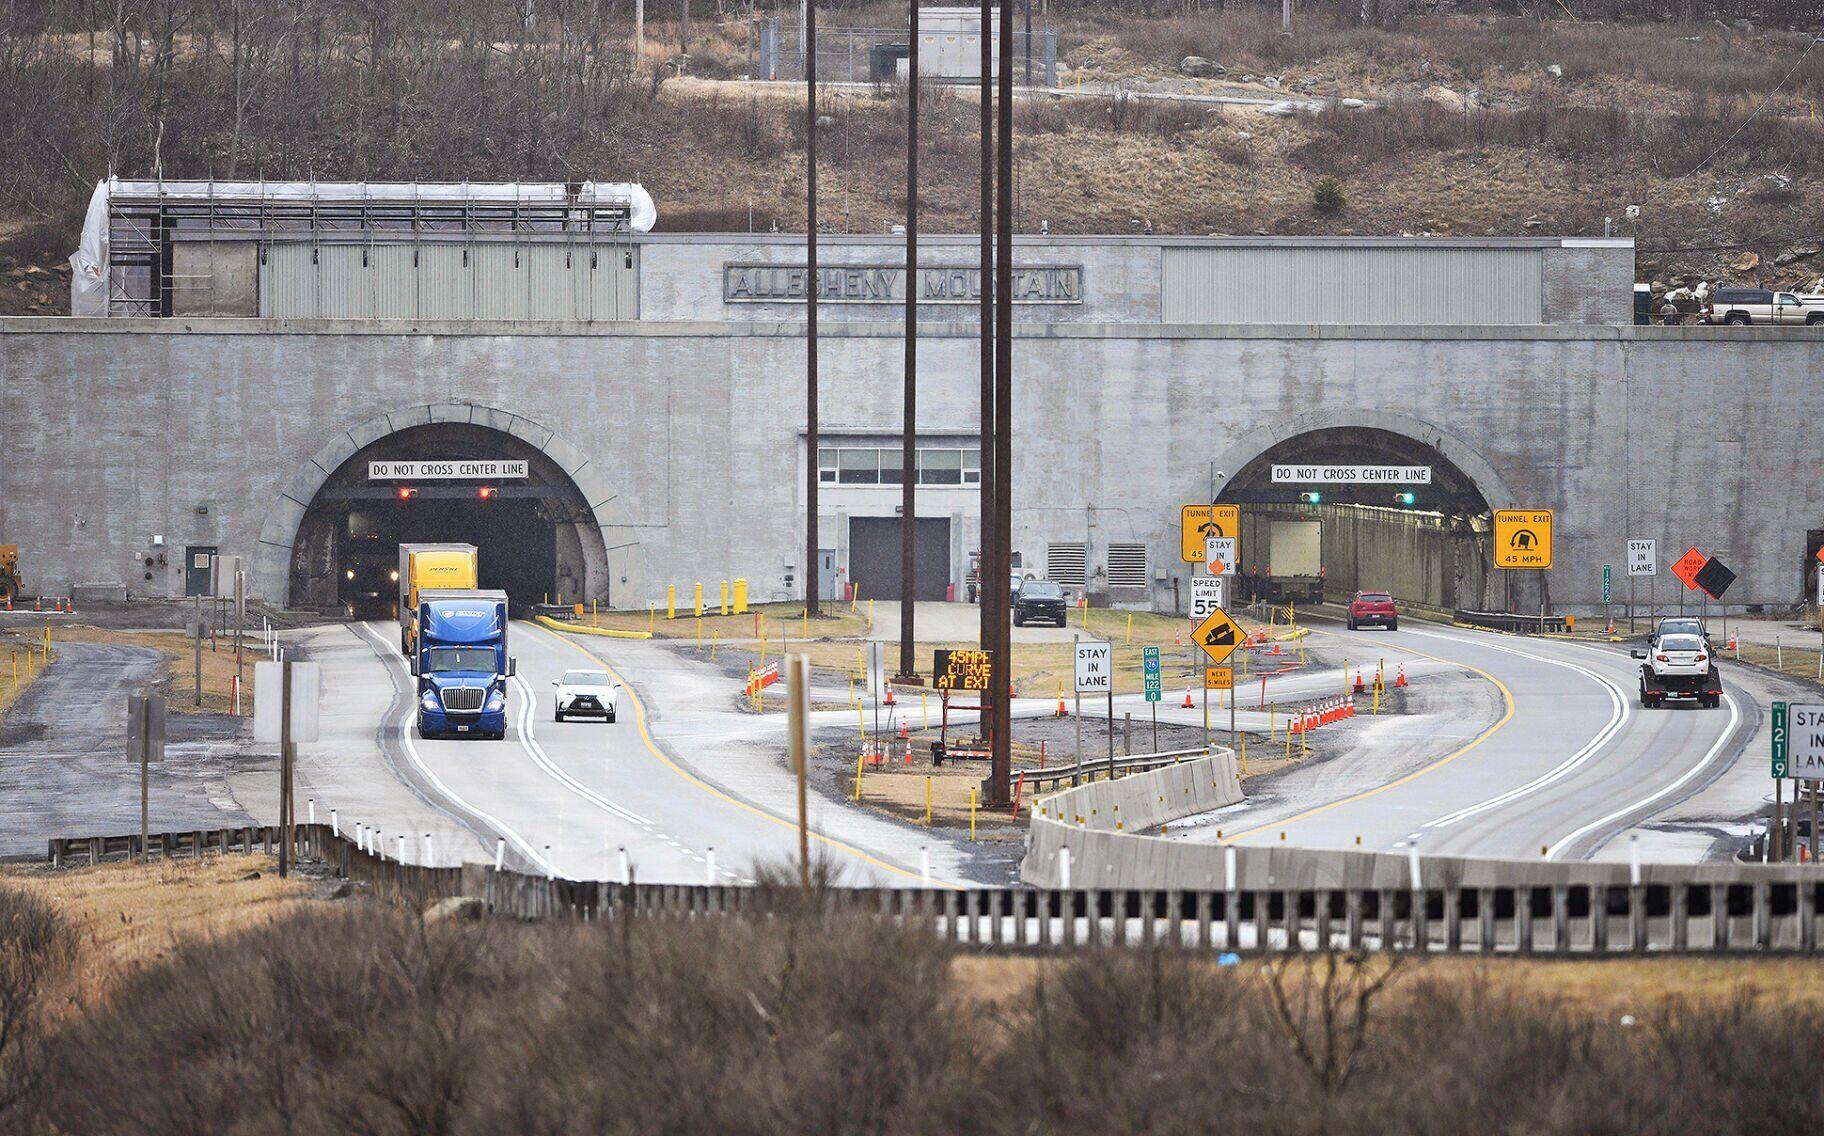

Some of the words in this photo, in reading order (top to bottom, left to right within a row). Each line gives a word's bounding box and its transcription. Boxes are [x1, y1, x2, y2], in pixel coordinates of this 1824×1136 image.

[924, 269, 1073, 298] MOUTAIN
[373, 464, 388, 476] DO
[394, 464, 414, 476] NOT
[420, 464, 453, 475] CROSS
[460, 464, 497, 474] CENTER
[502, 464, 524, 474] LINE
[1276, 468, 1290, 478] DO
[1297, 468, 1317, 479] NOT
[1324, 468, 1356, 480] CROSS
[1362, 469, 1400, 480] CENTER
[1406, 470, 1426, 480] LINE
[1631, 564, 1652, 572] LANE
[1194, 600, 1218, 614] 55
[1079, 649, 1107, 658] STAY
[948, 664, 991, 676] CURVE
[1088, 663, 1098, 672] IN
[938, 675, 956, 688] AT
[964, 676, 988, 689] EXI
[1079, 676, 1107, 686] LANE
[1797, 712, 1824, 726] STA
[1810, 734, 1824, 747] IN
[1796, 755, 1824, 768] LAN
